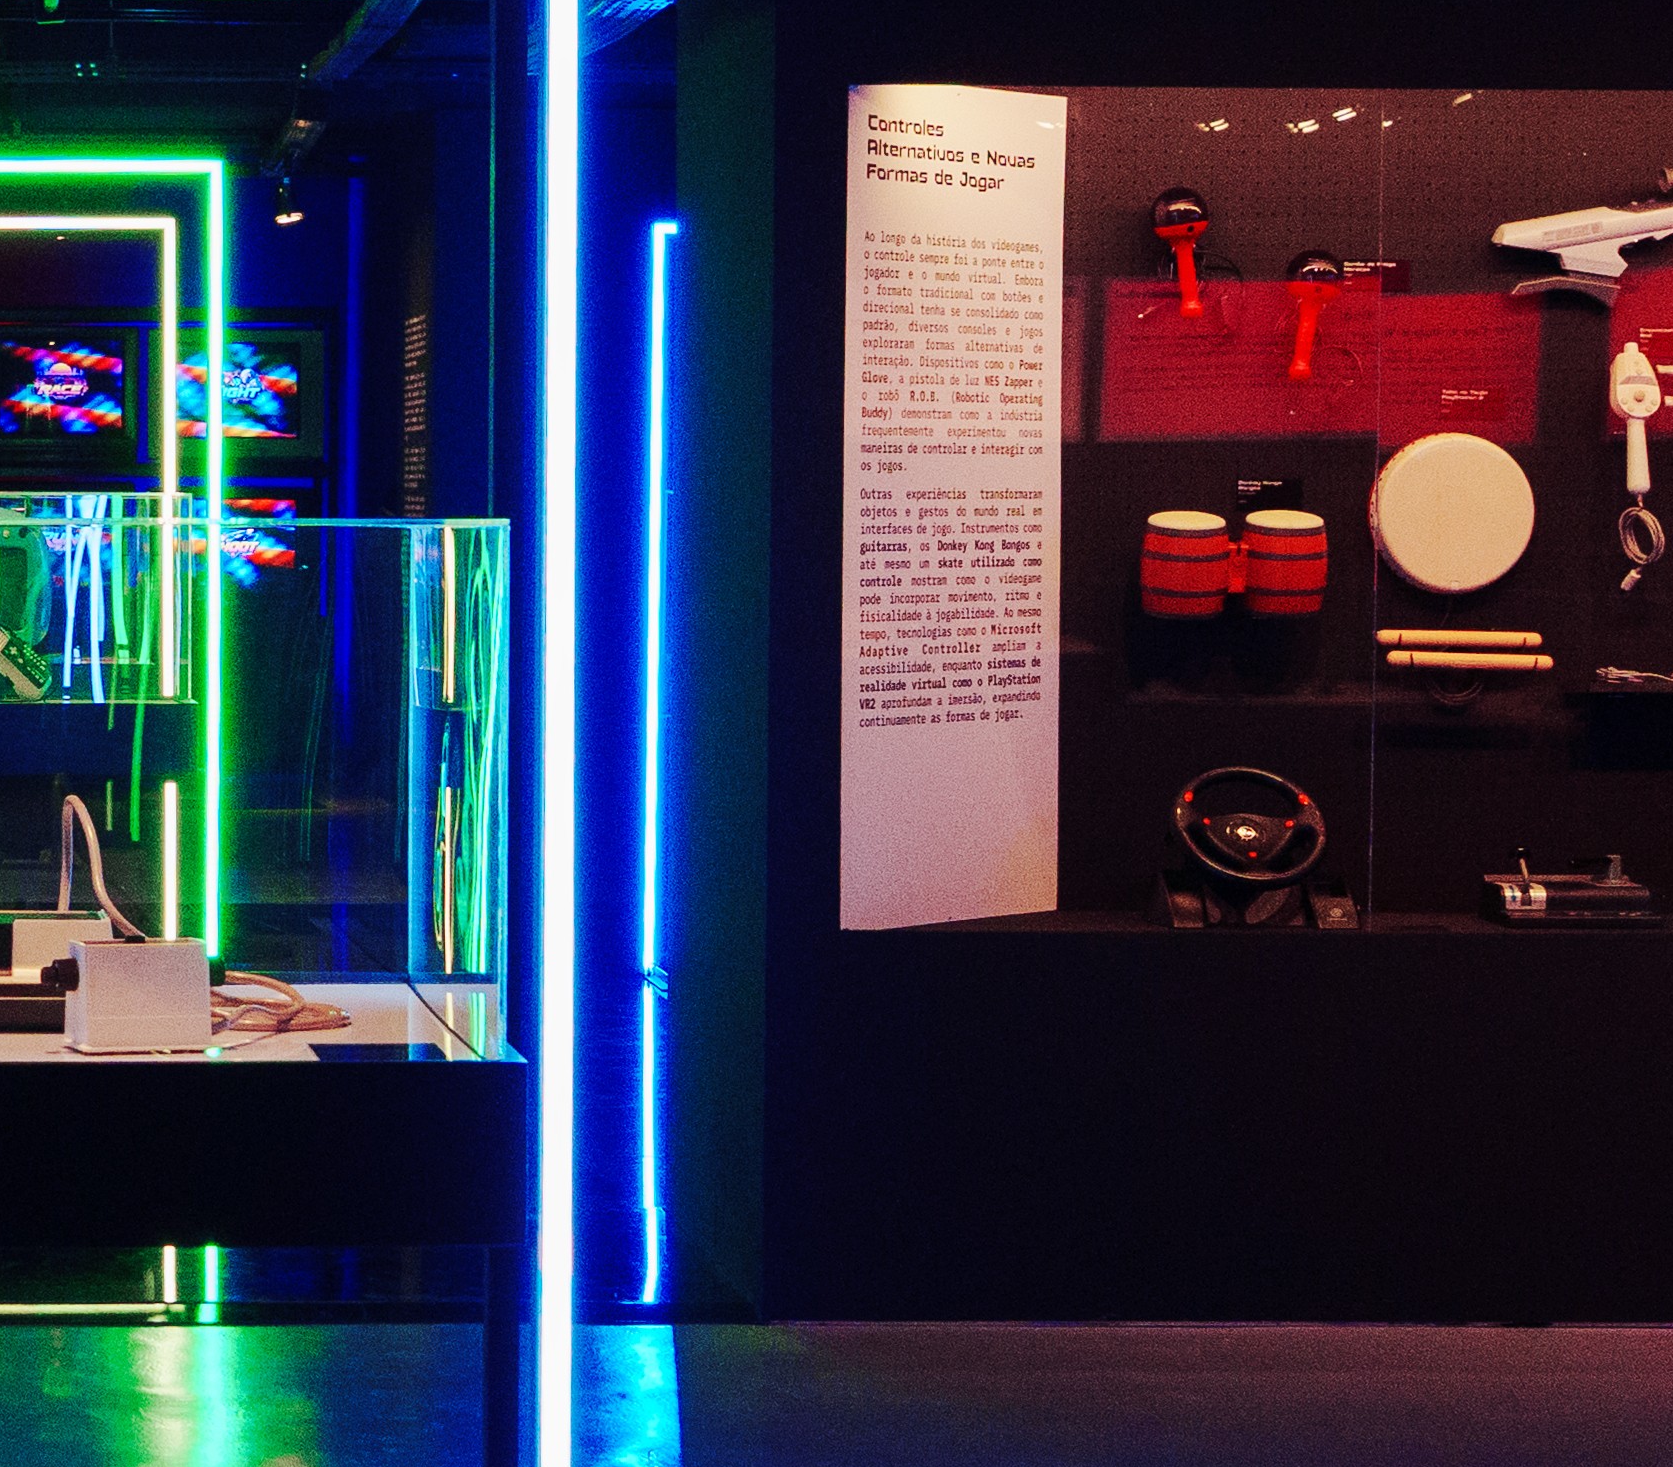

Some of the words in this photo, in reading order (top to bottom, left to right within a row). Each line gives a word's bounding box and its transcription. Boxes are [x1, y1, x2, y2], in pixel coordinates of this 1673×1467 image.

[868, 114, 944, 137] Controles
[867, 139, 964, 163] Alternativos
[971, 152, 980, 164] e
[987, 150, 1035, 169] Novas
[866, 163, 928, 184] Formas
[935, 169, 953, 185] de
[960, 172, 1004, 193] Jogar
[864, 231, 875, 241] Ao
[881, 232, 906, 245] longo
[910, 235, 921, 245] da
[926, 236, 966, 248] história
[971, 239, 986, 249] dos
[874, 251, 915, 262] controle
[919, 254, 949, 264] sempre
[954, 255, 968, 265] foi
[981, 256, 1007, 267] ponte
[1010, 259, 1035, 269] entre
[864, 268, 899, 280] jogador
[934, 272, 960, 281] mundo
[1014, 275, 1044, 286] Embora
[908, 322, 948, 333] diversos
[957, 325, 996, 335] consoles
[1020, 326, 1043, 339] jogos
[984, 361, 1004, 369] como
[1019, 360, 1043, 370] Power
[222, 387, 261, 398] IGHT
[860, 444, 903, 453] maneiras
[907, 444, 918, 453] de
[922, 444, 967, 454] controlar
[981, 444, 1024, 456] interagir
[860, 489, 892, 499] Outras
[861, 525, 913, 534] interfaces
[916, 524, 927, 534] de
[221, 541, 260, 552] HOOT
[937, 540, 967, 552] Donkey
[974, 540, 995, 552] Kong
[1001, 540, 1030, 552] Bongos
[1003, 607, 1014, 617] Ao
[896, 626, 952, 639] tecnologias
[956, 628, 977, 636] como
[990, 624, 1041, 635] Microsoft
[859, 646, 908, 658] Adaptive
[921, 643, 980, 655] Controller
[992, 640, 1026, 652] ampliam
[859, 681, 906, 692] realidade
[911, 679, 946, 690] virtual
[952, 679, 972, 687] como
[987, 674, 1041, 687] PlayStation
[946, 712, 976, 722] formas
[980, 710, 990, 720] de
